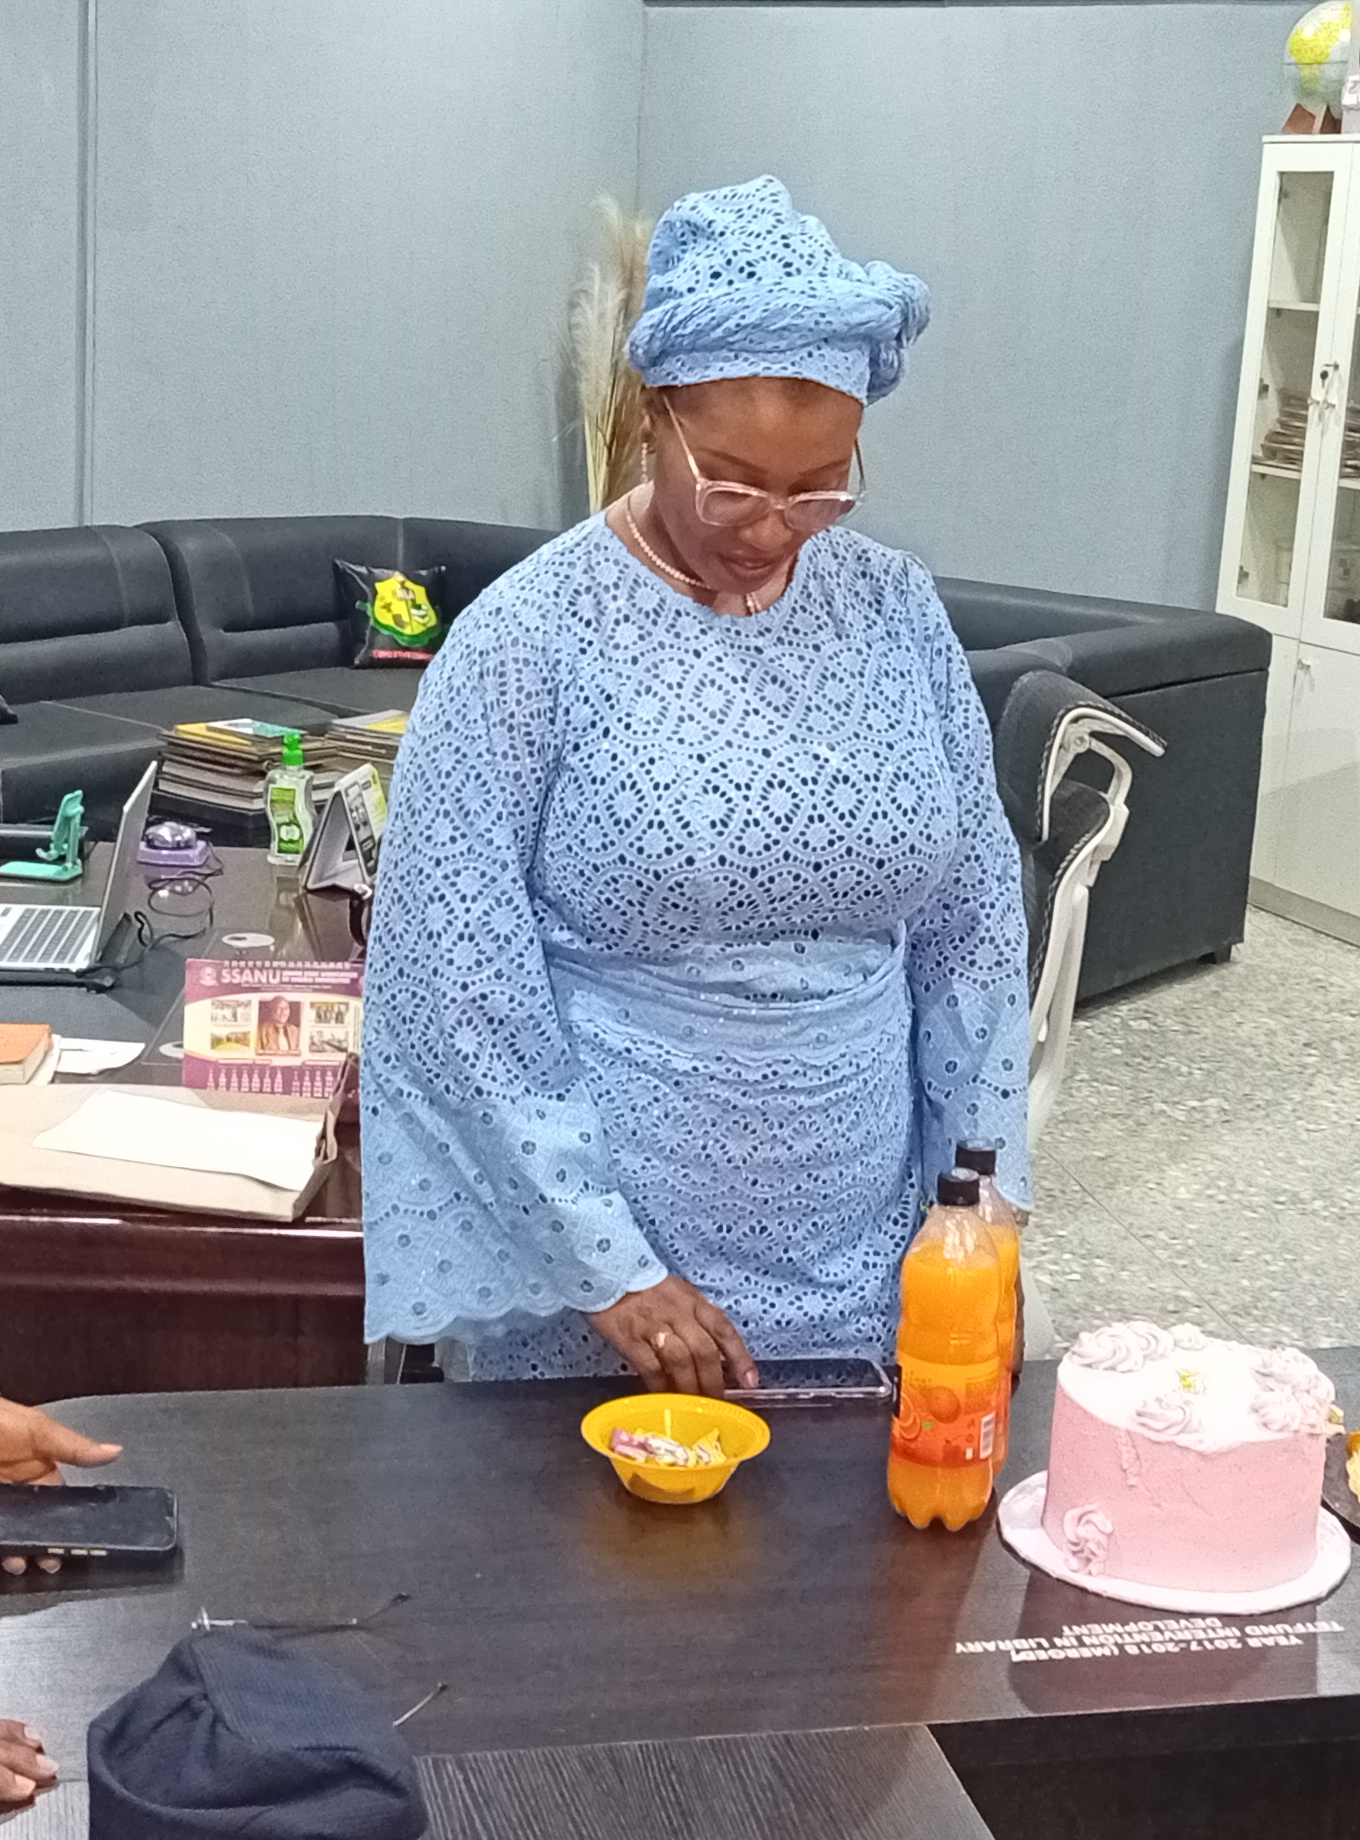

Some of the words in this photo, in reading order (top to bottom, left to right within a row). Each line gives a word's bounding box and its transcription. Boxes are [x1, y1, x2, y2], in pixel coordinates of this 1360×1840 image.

[221, 968, 281, 985] SSANU
[1061, 1616, 1223, 1638] DEVELOPMENT
[1245, 1621, 1345, 1637] TETFUND
[1054, 1635, 1080, 1649] IN
[1084, 1626, 1241, 1647] INTERVENTION
[1246, 1634, 1304, 1648] YEAR
[955, 1638, 1049, 1655] LIBRARY
[1127, 1638, 1242, 1656] 2017-2018
